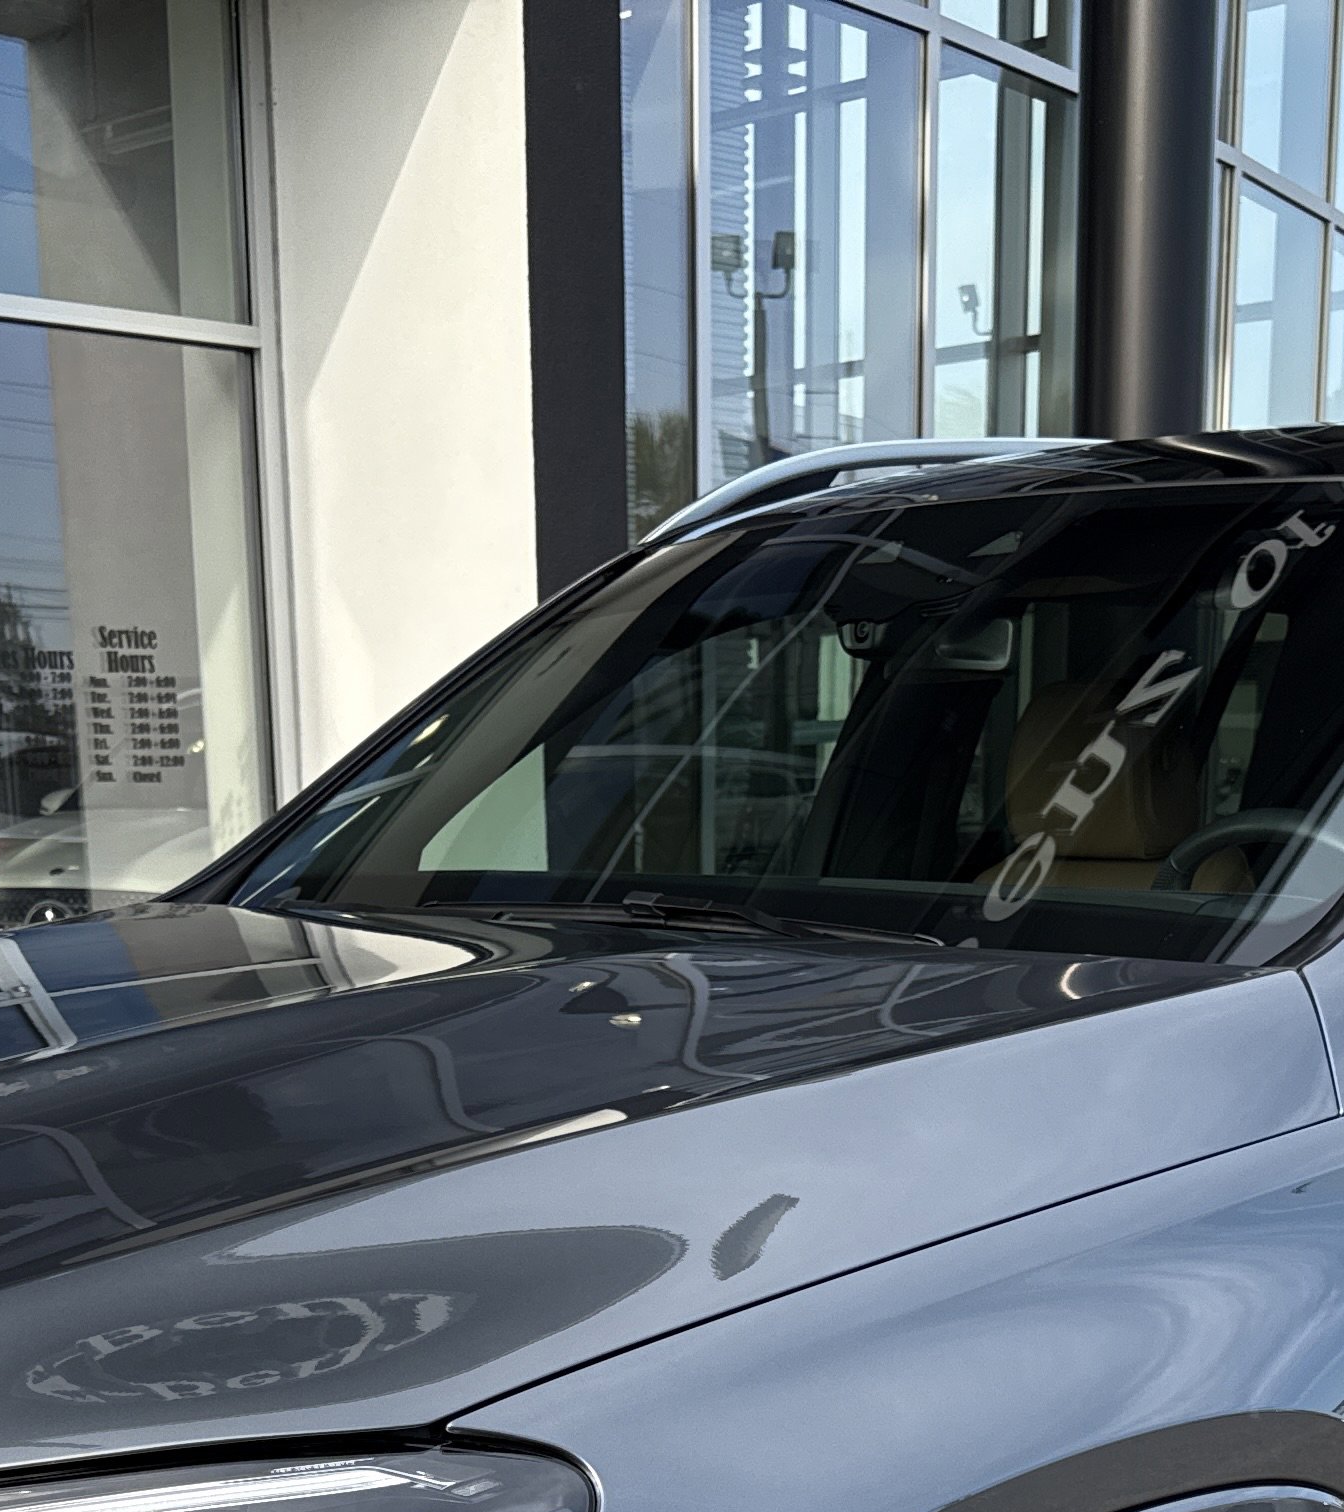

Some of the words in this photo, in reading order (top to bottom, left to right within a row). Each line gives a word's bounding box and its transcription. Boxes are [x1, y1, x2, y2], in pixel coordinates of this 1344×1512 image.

[98, 625, 158, 650] Service
[23, 647, 74, 670] Hours
[107, 651, 155, 674] Hours
